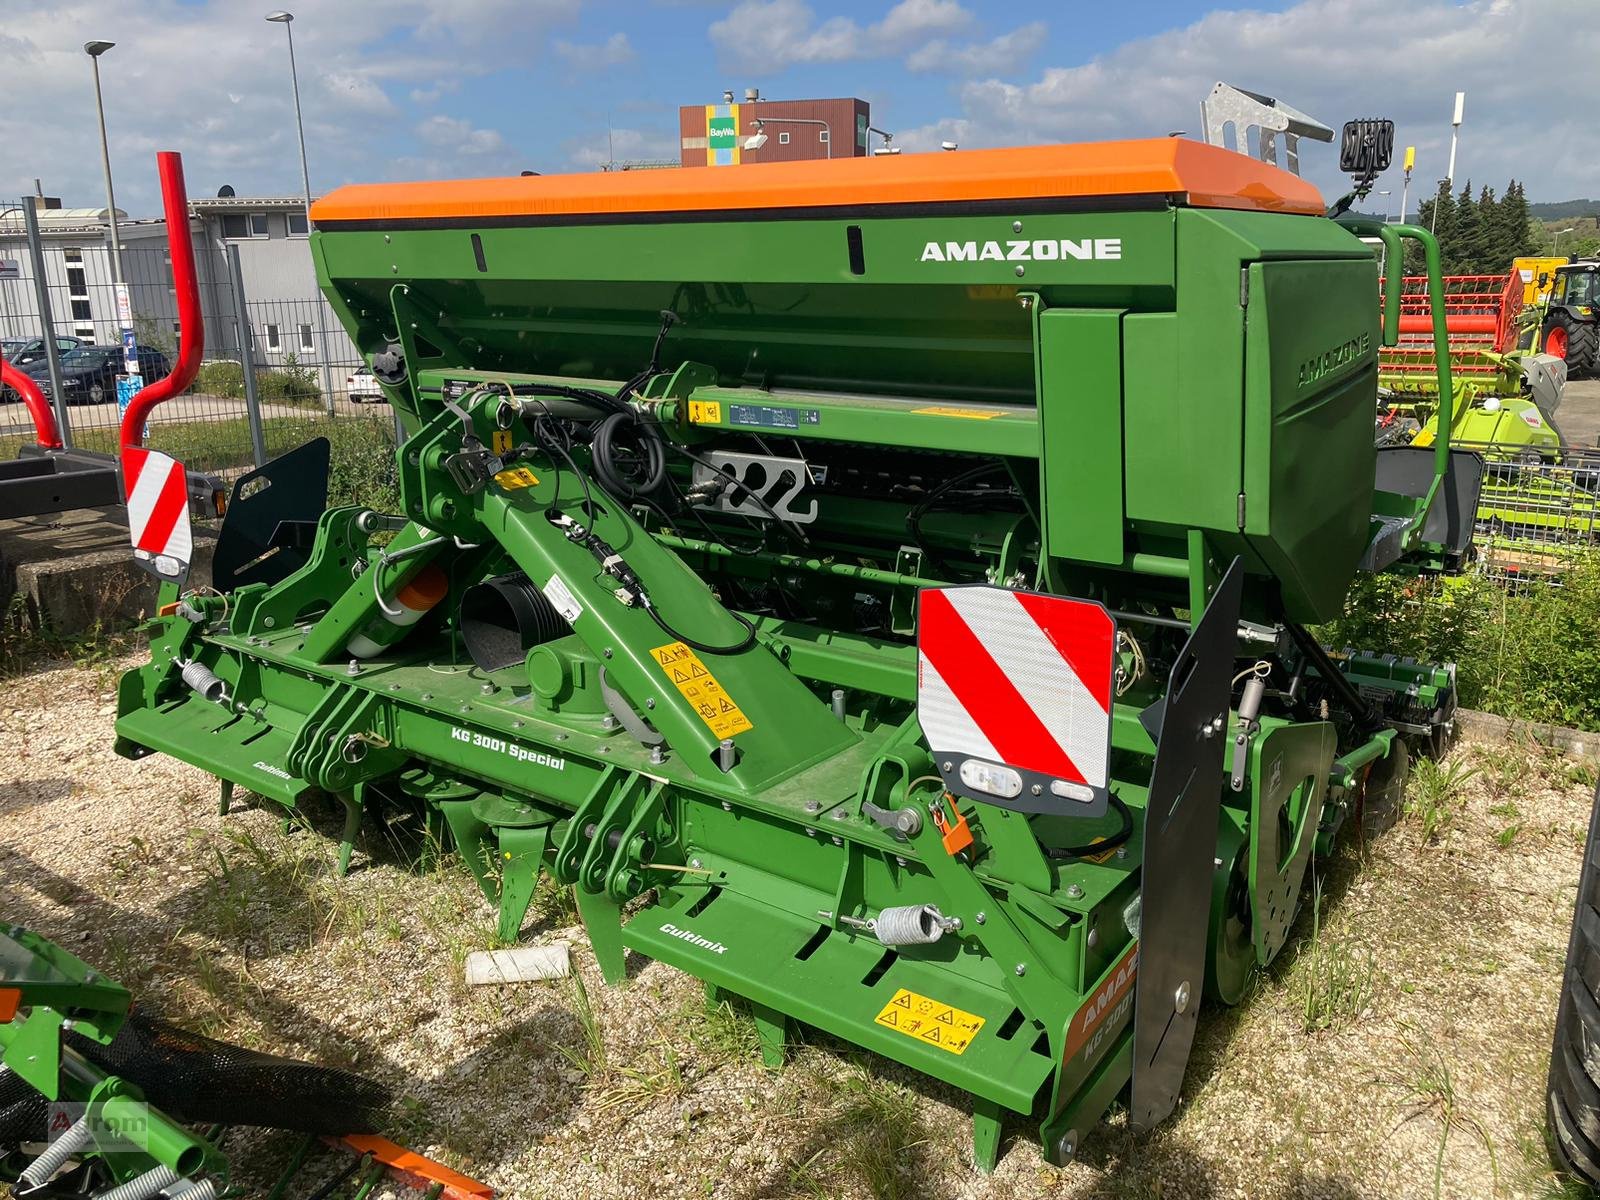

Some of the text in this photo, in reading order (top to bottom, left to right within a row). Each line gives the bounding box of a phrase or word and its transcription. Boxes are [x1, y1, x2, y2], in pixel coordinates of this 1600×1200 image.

[710, 127, 735, 138] BayWa
[920, 238, 1122, 262] AMAZONE
[1297, 331, 1370, 389] AMAZONE
[451, 726, 566, 771] KG 3001 Special
[659, 922, 729, 954] Cultimix
[1084, 1028, 1104, 1062] KG
